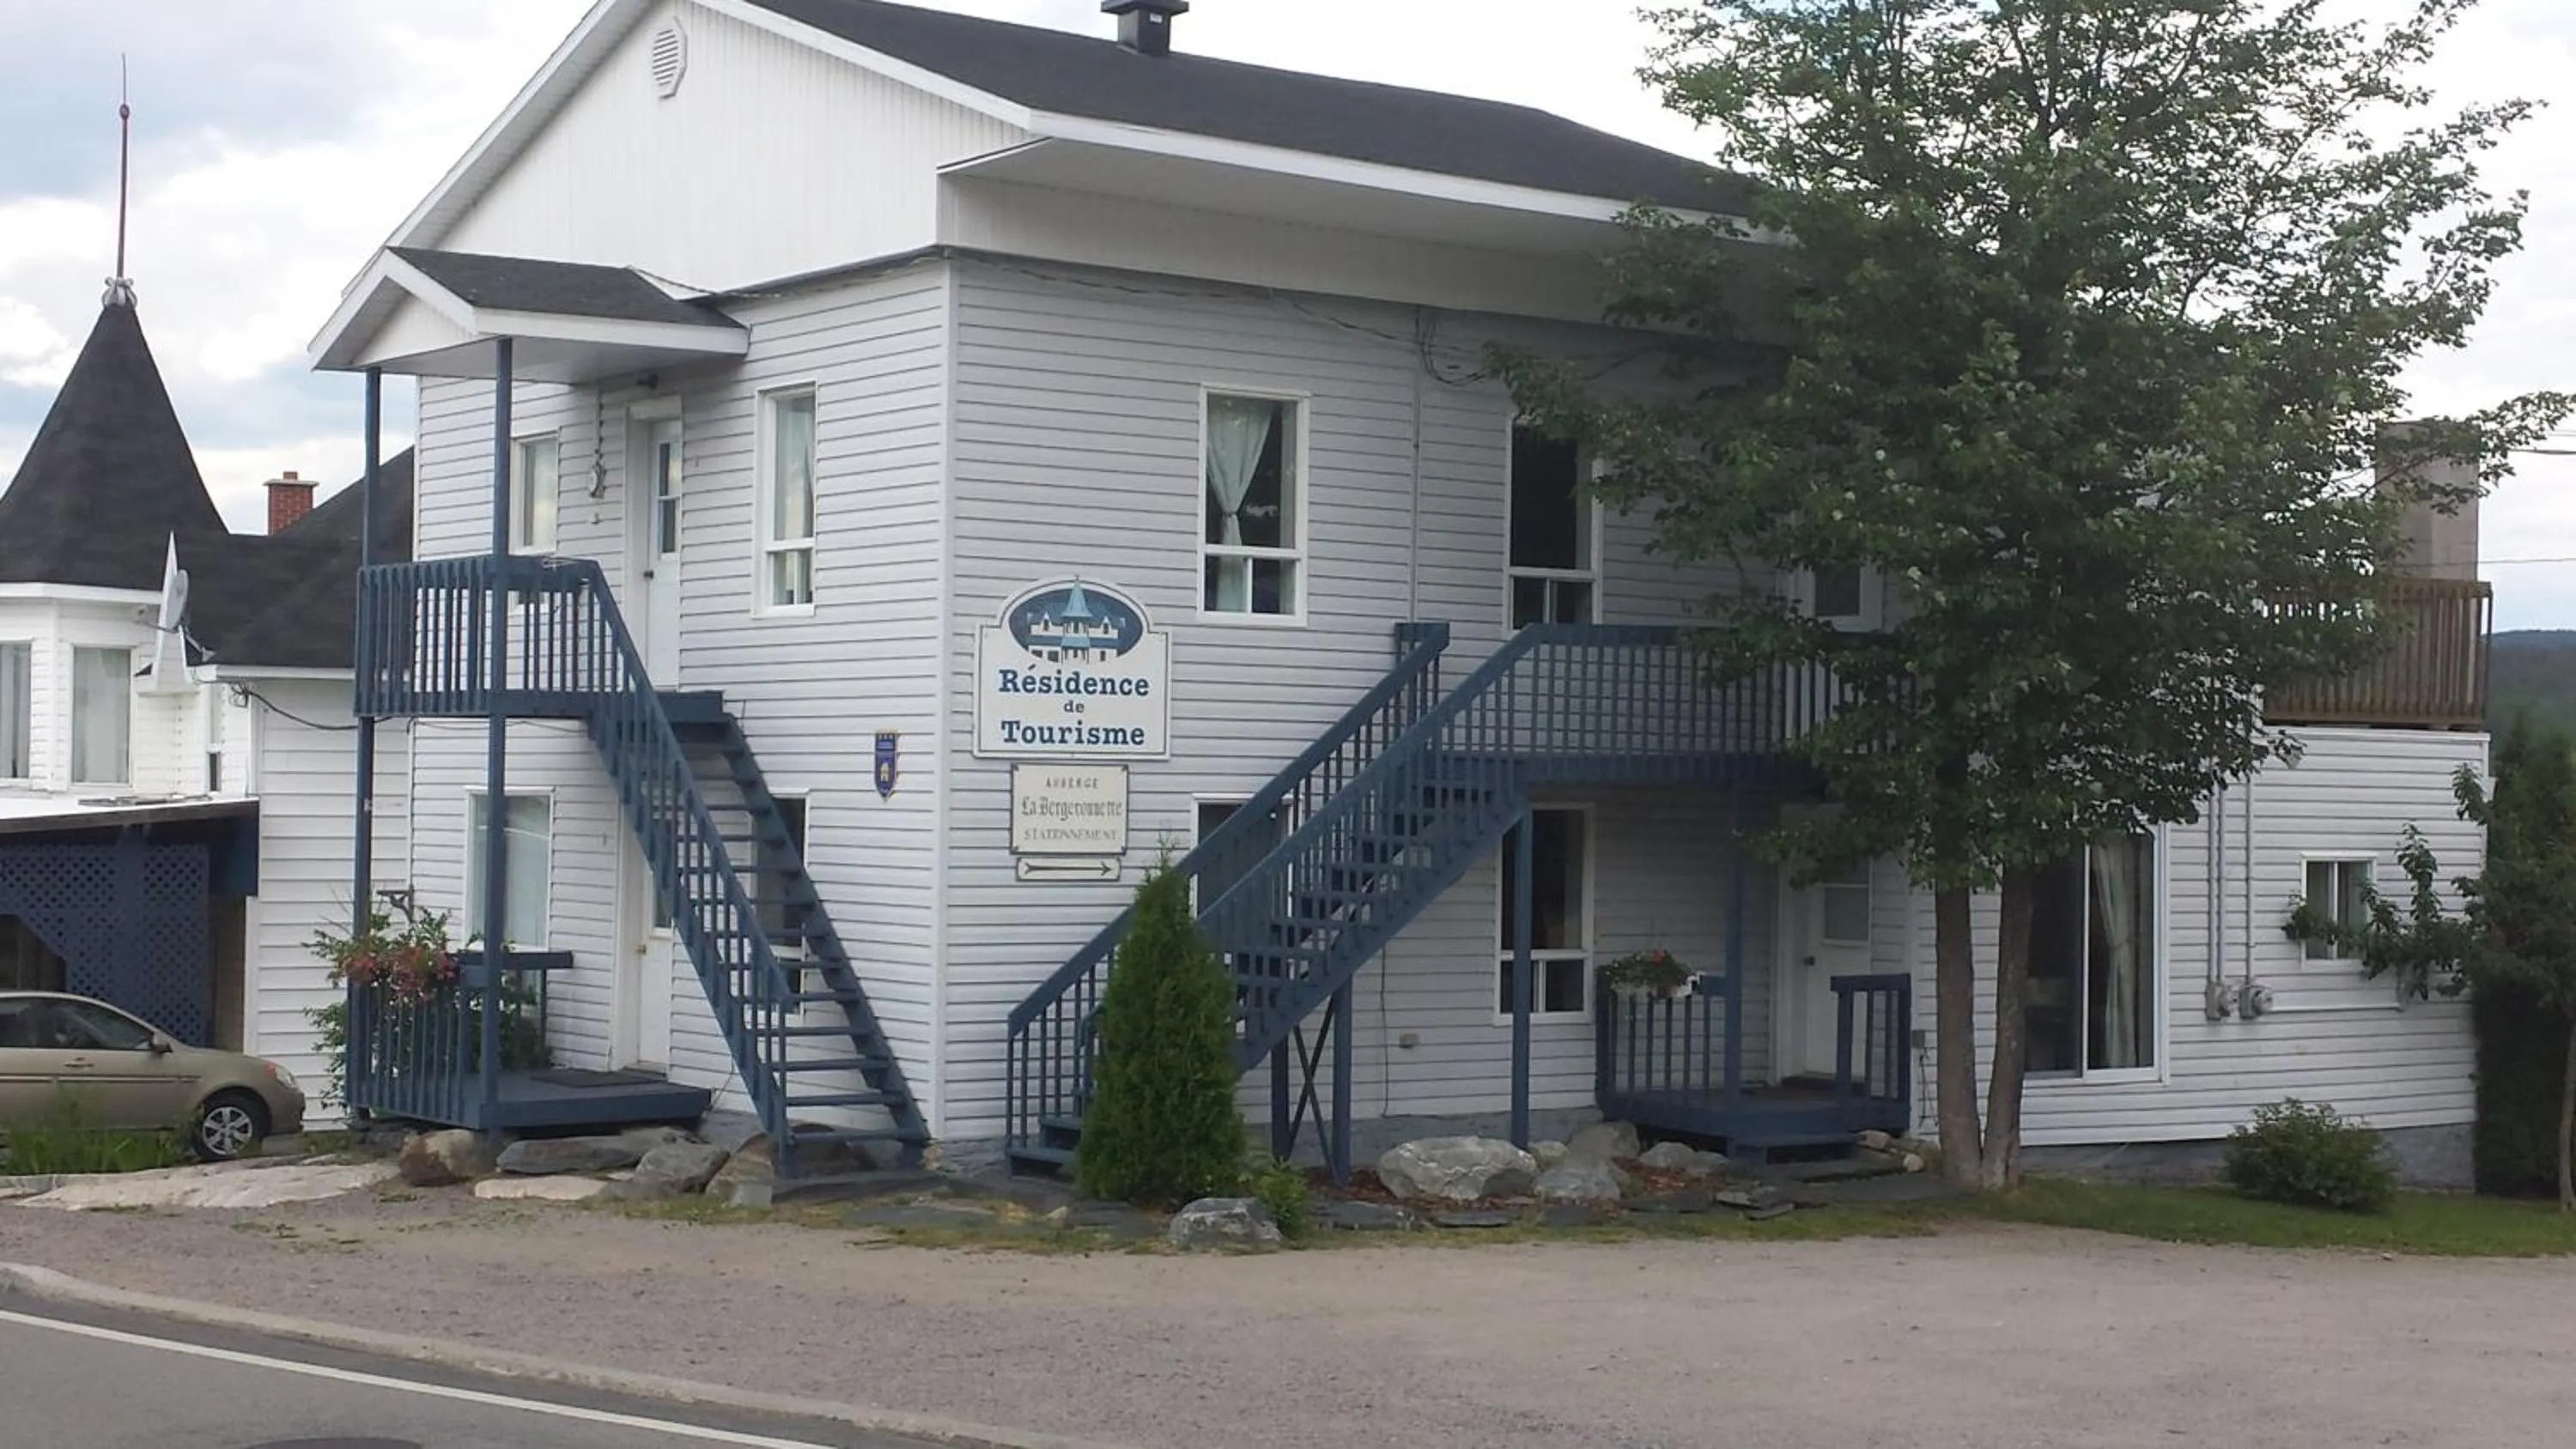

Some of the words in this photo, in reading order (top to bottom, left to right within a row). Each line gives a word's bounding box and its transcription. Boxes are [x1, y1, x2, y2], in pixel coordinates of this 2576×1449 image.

[998, 664, 1150, 696] Résidence
[1063, 700, 1084, 713] de
[1000, 719, 1145, 745] Tourisme
[1046, 776, 1098, 789] AUBERGE
[1021, 796, 1036, 815] La
[1024, 828, 1117, 841] STATIONNEMENT
